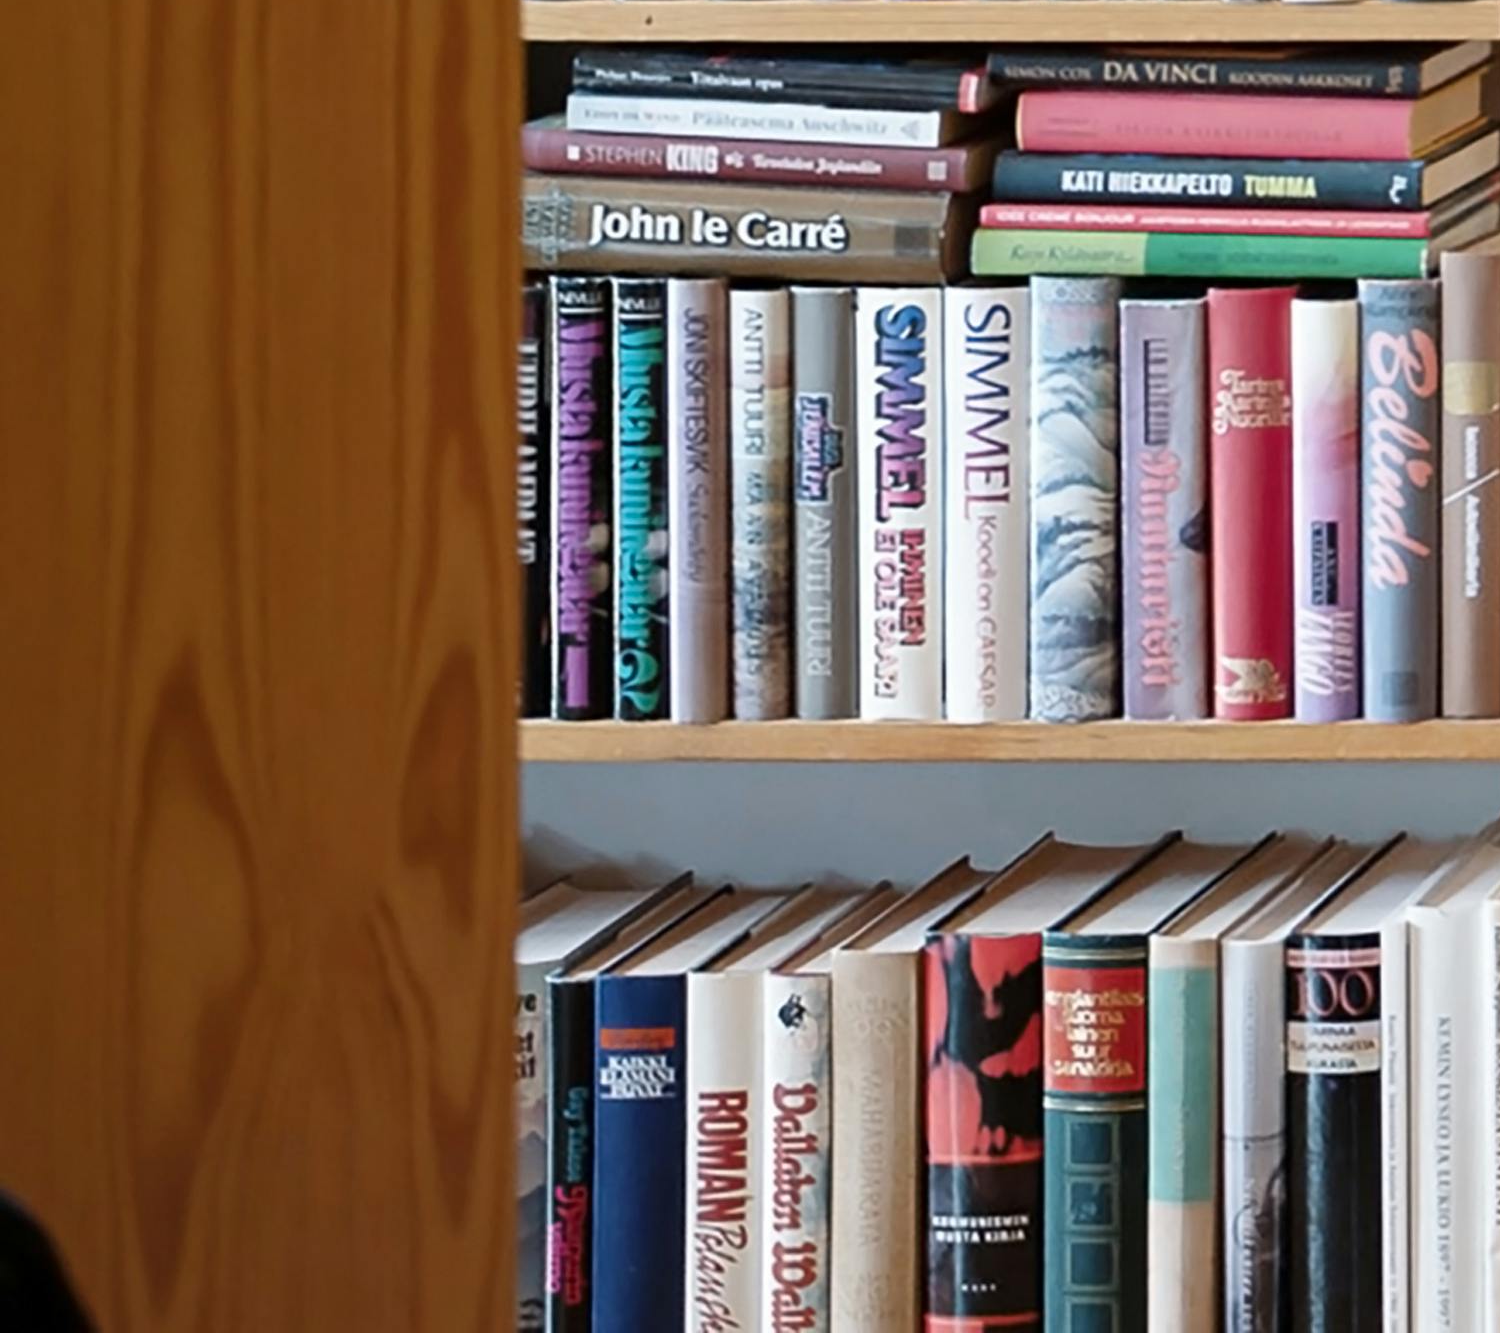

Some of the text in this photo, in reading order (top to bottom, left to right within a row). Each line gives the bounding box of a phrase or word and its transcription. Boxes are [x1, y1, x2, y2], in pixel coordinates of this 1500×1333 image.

[1103, 59, 1138, 84] DA
[1143, 61, 1219, 86] VINCI
[584, 144, 719, 173] STEPHEN KING
[1061, 169, 1318, 198] KATI HIEKKAPELTO TUMMA
[589, 202, 848, 253] John le Carré
[743, 308, 765, 375] ANTTI
[744, 386, 766, 457] TUURI
[874, 302, 928, 524] SIMMEL
[962, 302, 1012, 522] SIMMEL
[1366, 327, 1440, 591] Belinda
[805, 511, 831, 595] ANTTI
[975, 515, 999, 577] Koodi
[874, 559, 899, 615] OLE
[900, 528, 926, 646] IHMINEN
[975, 580, 993, 611] on
[1294, 967, 1376, 1018] 100
[1435, 1016, 1452, 1078] KEMIN
[696, 1089, 749, 1224] ROMAN
[1435, 1169, 1452, 1228] LUKIO
[1435, 1232, 1452, 1273] 1897
